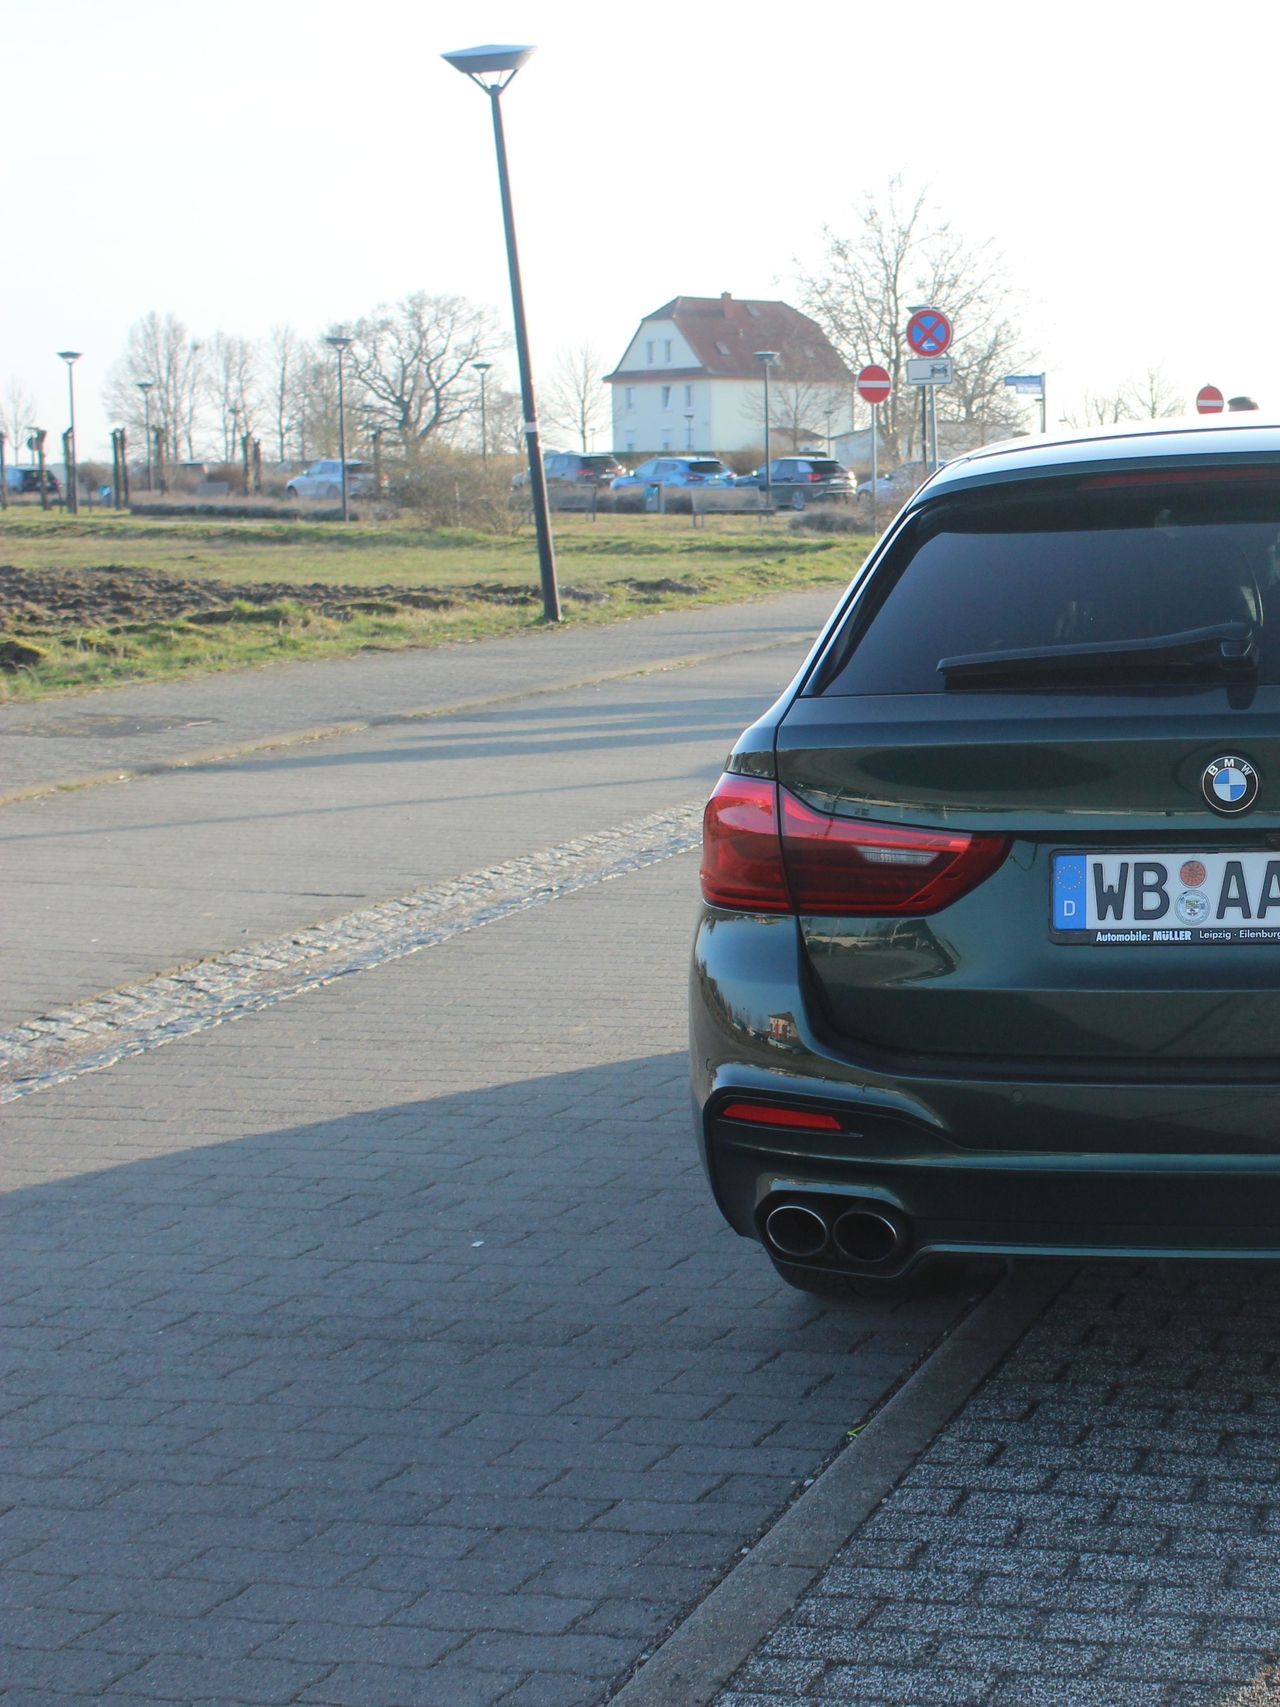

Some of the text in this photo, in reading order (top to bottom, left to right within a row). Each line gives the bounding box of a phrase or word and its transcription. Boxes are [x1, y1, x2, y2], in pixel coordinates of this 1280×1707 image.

[1207, 758, 1253, 776] BMW
[1092, 861, 1170, 921] WB
[1063, 900, 1076, 916] D
[1096, 931, 1151, 942] Automobile:
[1199, 930, 1231, 940] Leipzig
